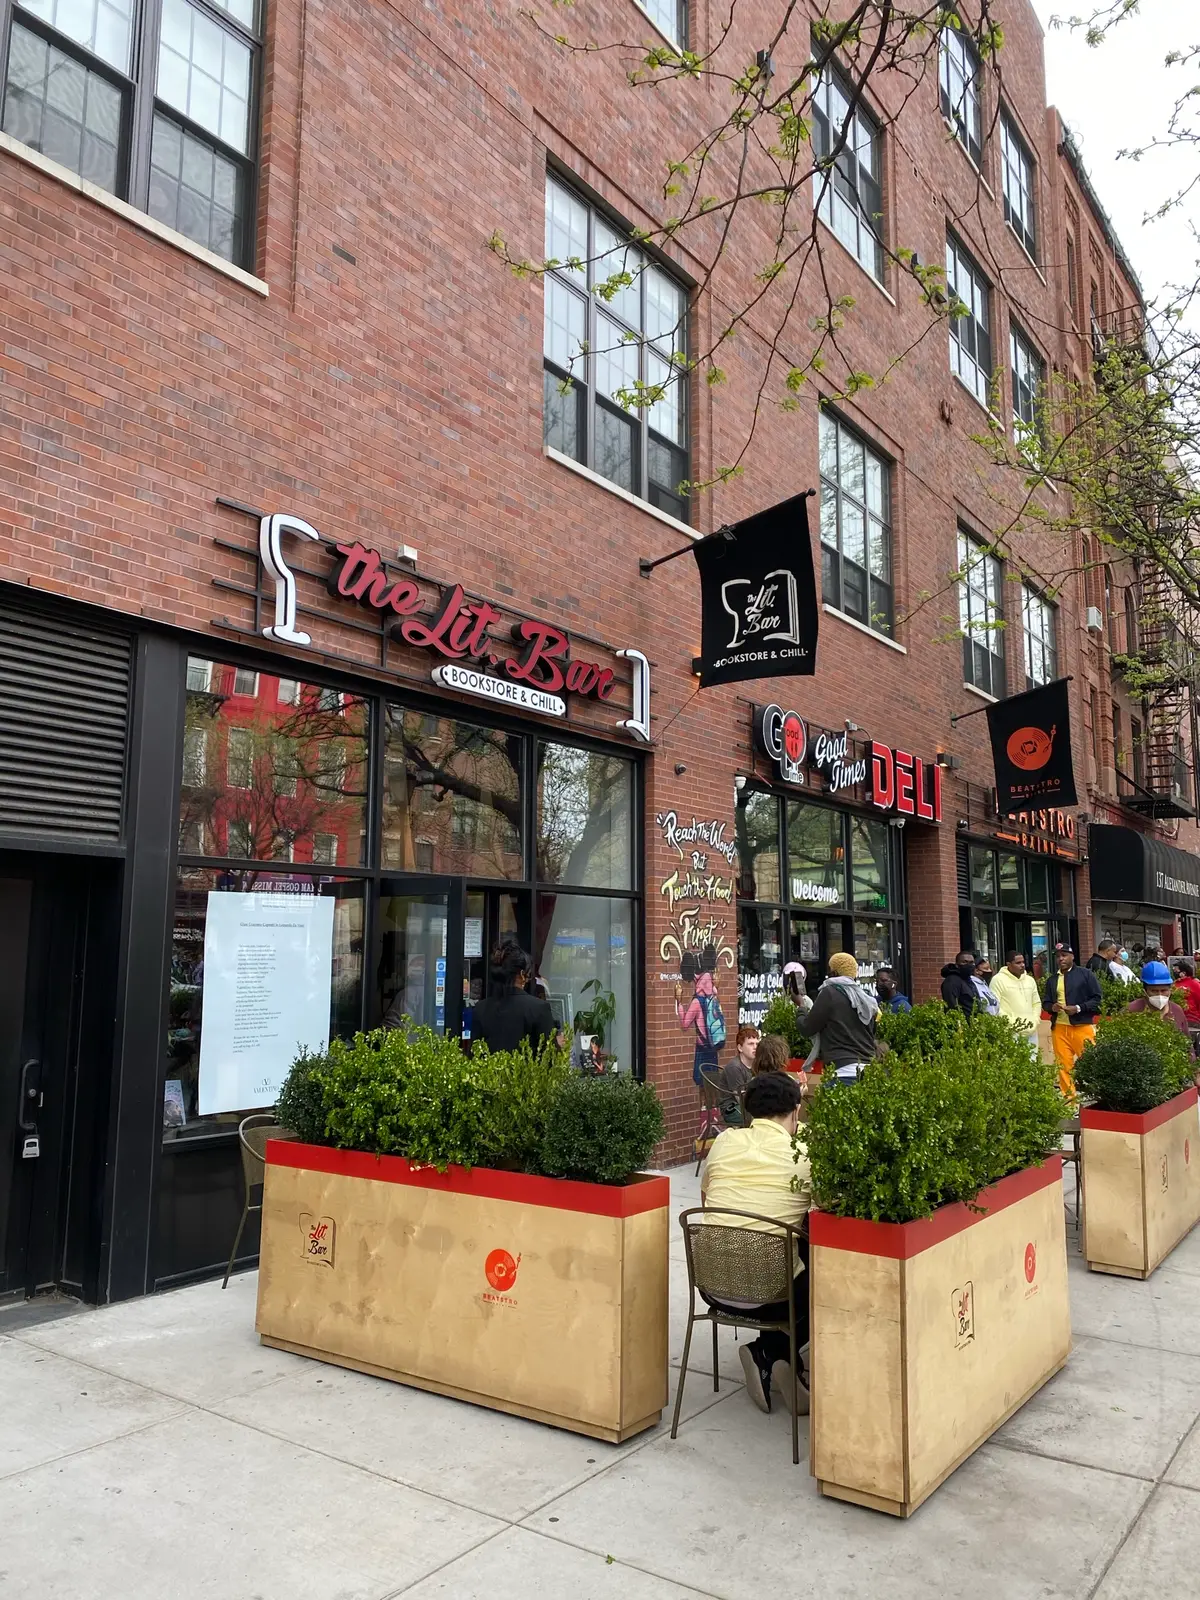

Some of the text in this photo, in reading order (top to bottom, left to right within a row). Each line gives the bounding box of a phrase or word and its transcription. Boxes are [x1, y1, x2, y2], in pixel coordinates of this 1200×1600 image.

[742, 613, 781, 635] Bar
[506, 621, 617, 700] Bar
[770, 650, 777, 659] &
[780, 648, 806, 658] CHILL
[451, 668, 558, 712] BOOKSTORE & CHILL
[815, 730, 848, 768] Good
[829, 759, 866, 793] Times
[872, 740, 942, 822] DELI
[691, 849, 708, 871] But
[660, 869, 692, 912] Touch
[703, 875, 733, 905] Hood
[792, 878, 839, 904] Welcome
[744, 974, 759, 989] Hot
[759, 974, 766, 988] &
[308, 1239, 328, 1255] Bar
